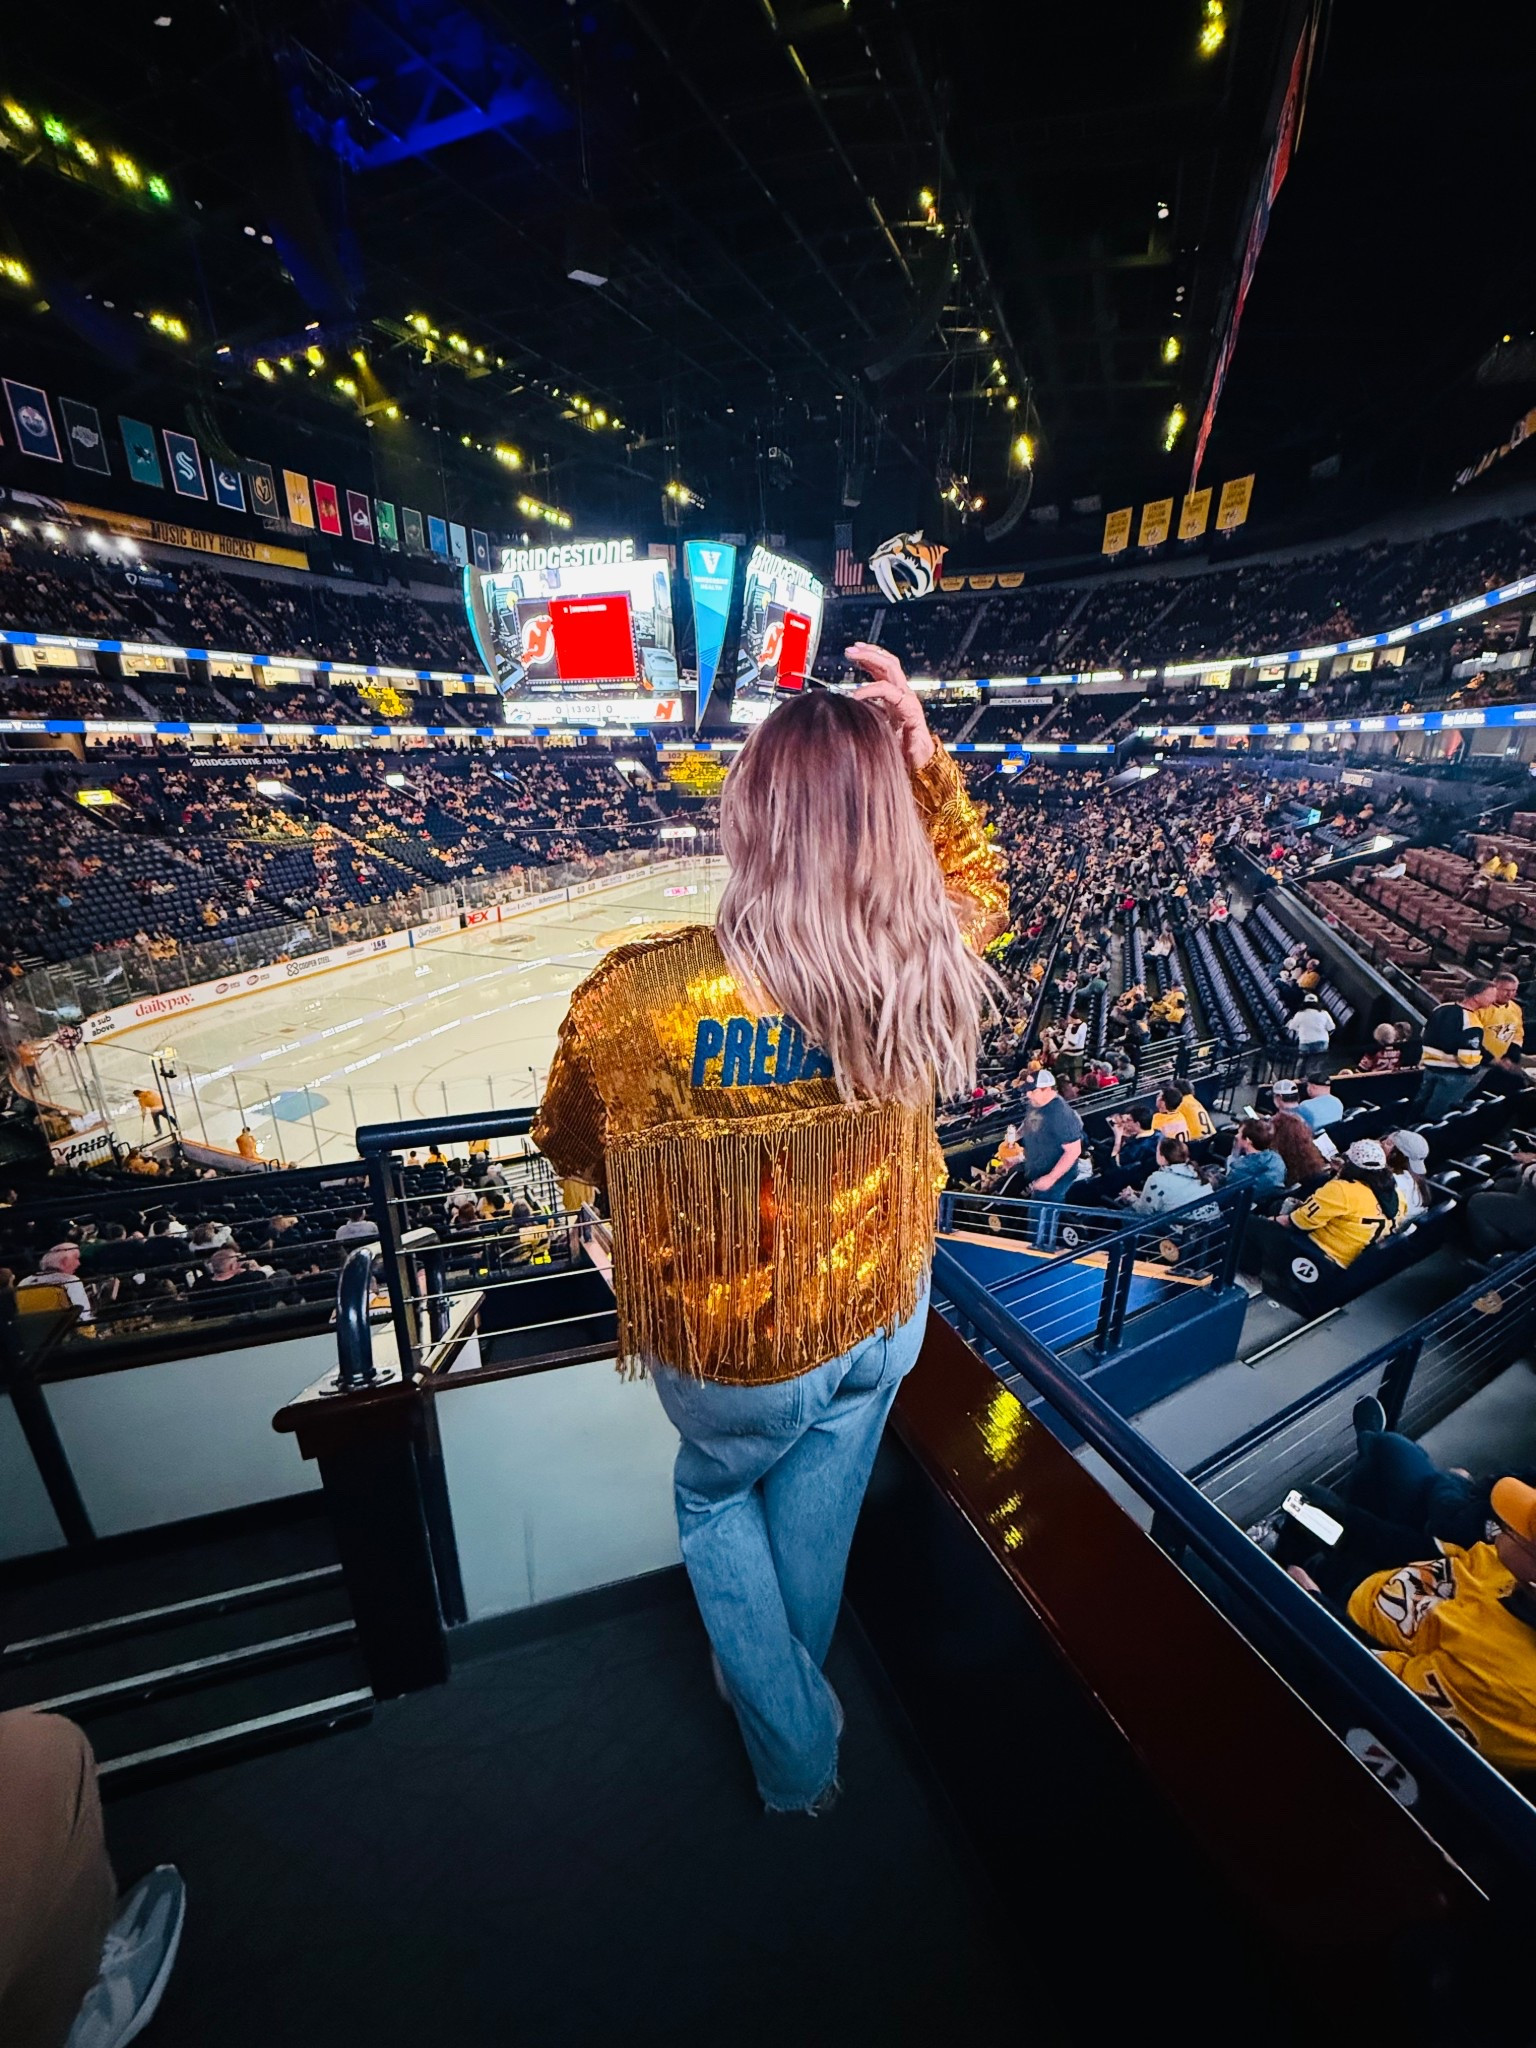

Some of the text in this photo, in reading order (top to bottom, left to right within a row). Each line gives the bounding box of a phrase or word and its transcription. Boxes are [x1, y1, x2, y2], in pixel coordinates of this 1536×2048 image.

[151, 520, 257, 559] MUSIC CITY HOCKEY
[502, 538, 634, 574] BRIDGESTONE
[752, 544, 814, 591] BRIDGESTONE
[556, 705, 613, 715] 0 13:02 0
[190, 757, 289, 767] BRIDGESTONE ARENA
[298, 955, 331, 971] COOPER STEEL
[134, 993, 195, 1018] dailypay.
[90, 1014, 112, 1029] a sub
[92, 1022, 116, 1037] above
